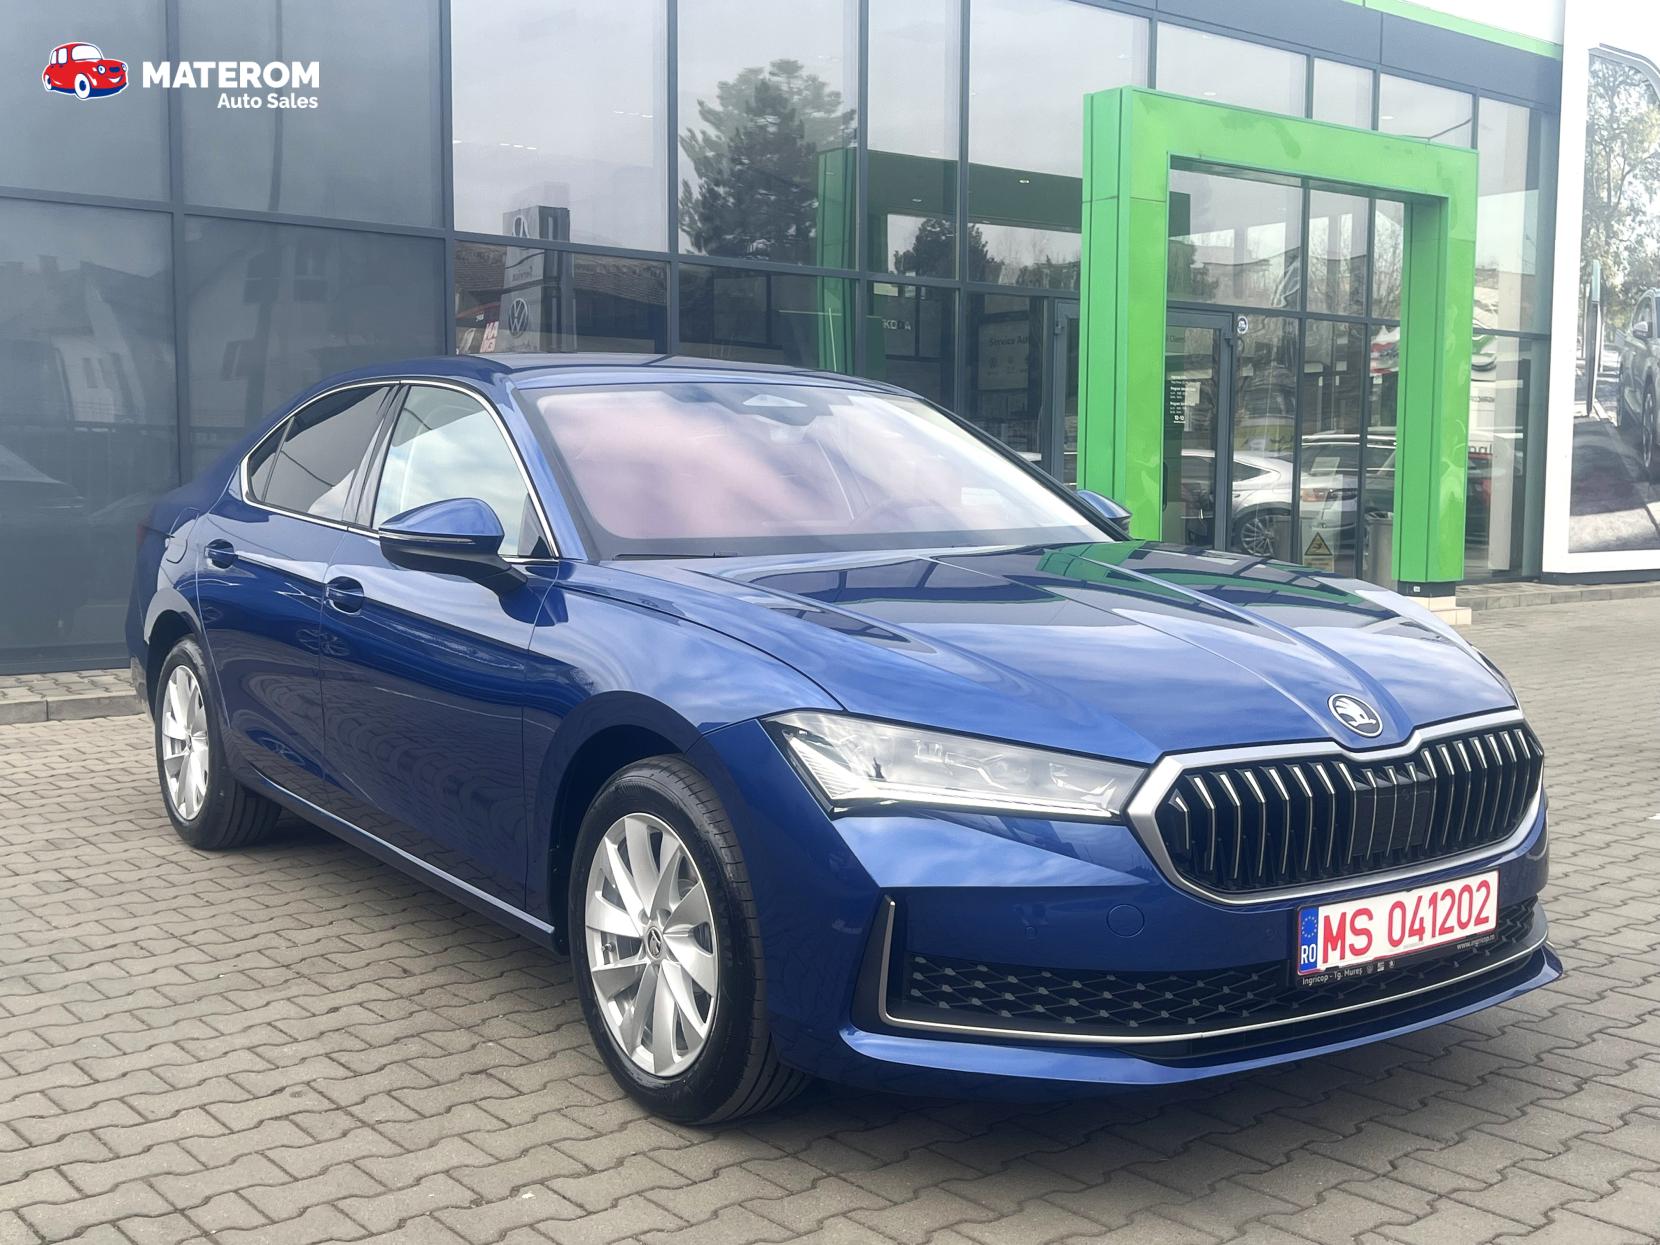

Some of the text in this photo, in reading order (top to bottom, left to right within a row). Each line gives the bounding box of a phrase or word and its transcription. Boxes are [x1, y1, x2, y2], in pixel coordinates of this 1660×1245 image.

[1322, 880, 1491, 964] MS 041202
[1301, 943, 1317, 965] RO
[1302, 974, 1329, 986] Ingricop
